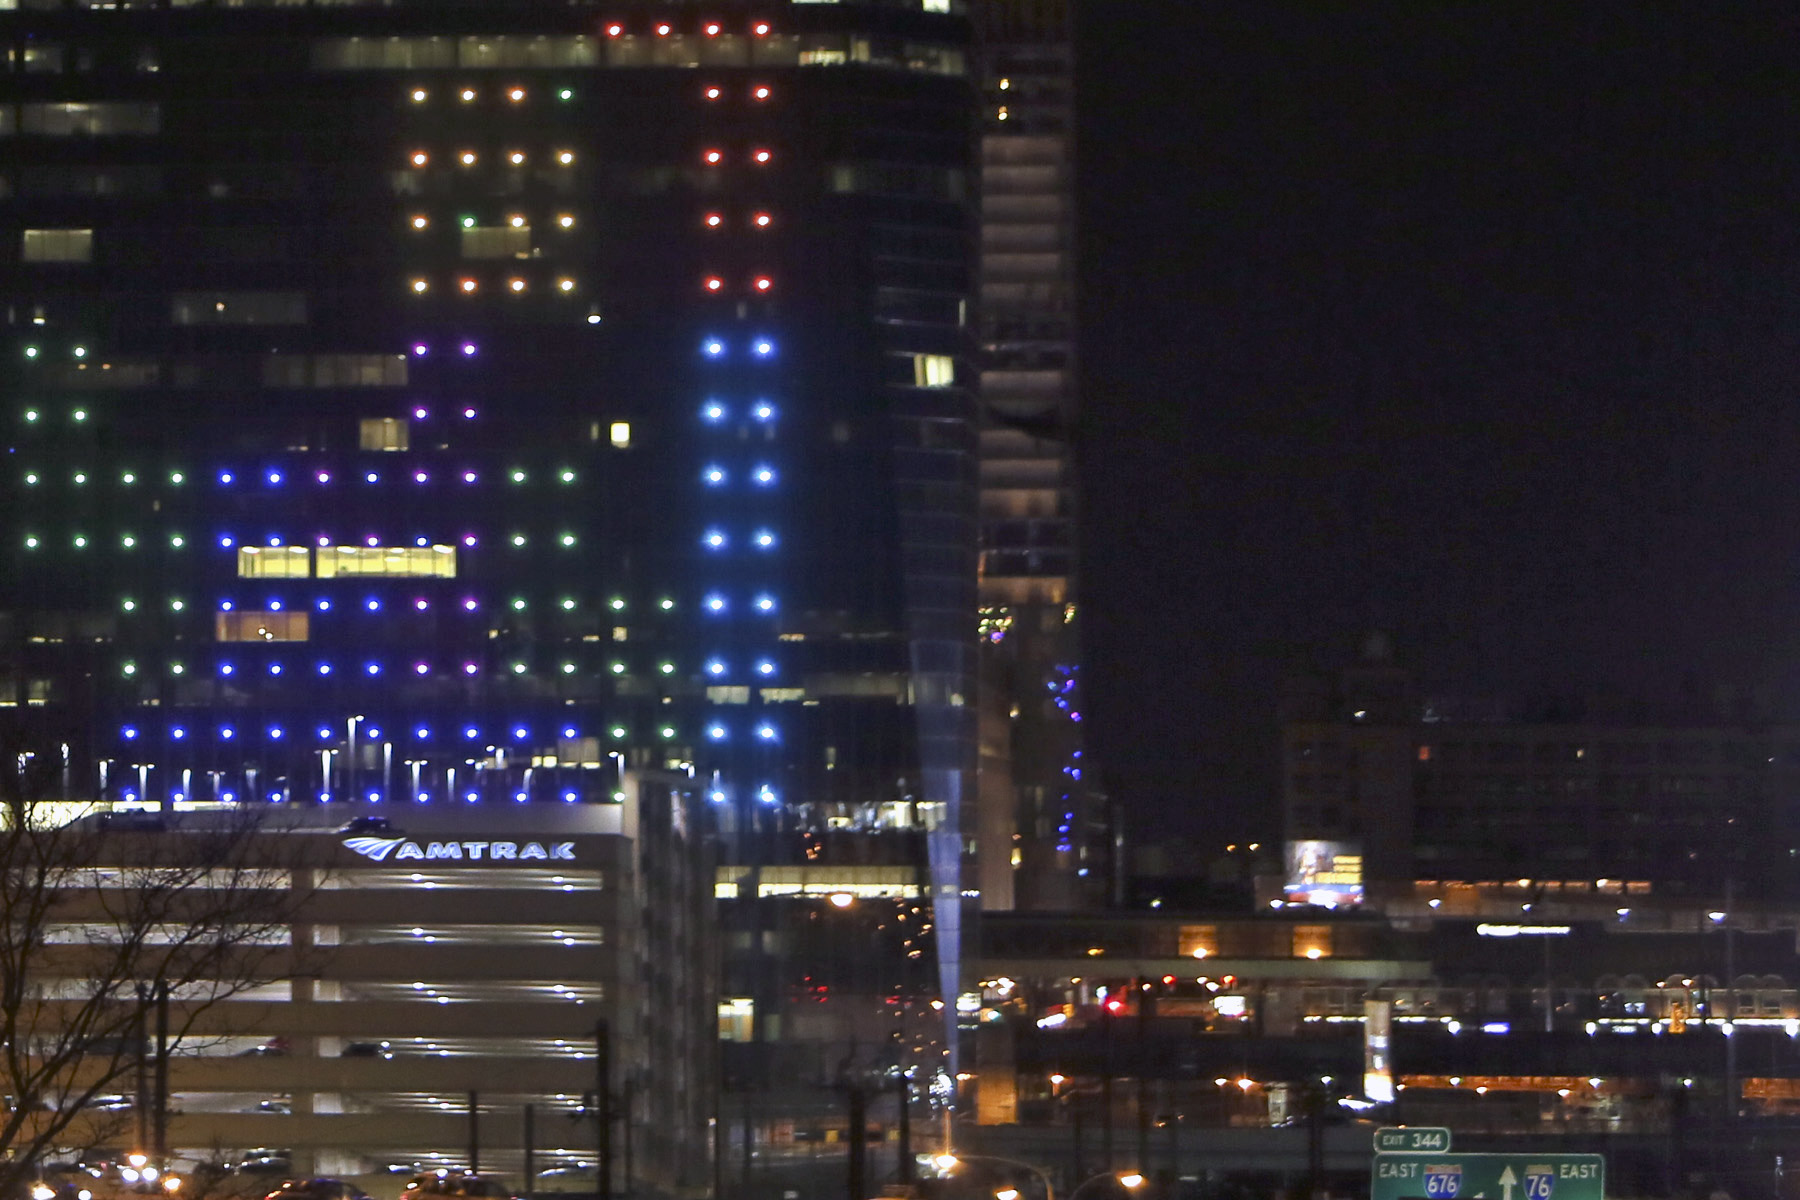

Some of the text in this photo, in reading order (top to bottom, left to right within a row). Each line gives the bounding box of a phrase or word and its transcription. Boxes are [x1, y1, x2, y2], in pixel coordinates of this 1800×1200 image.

[395, 841, 576, 860] AMTRAK
[1382, 1133, 1442, 1148] EXIT 344
[1379, 1163, 1457, 1193] EAST 676
[1527, 1164, 1598, 1197] 76 EAST
